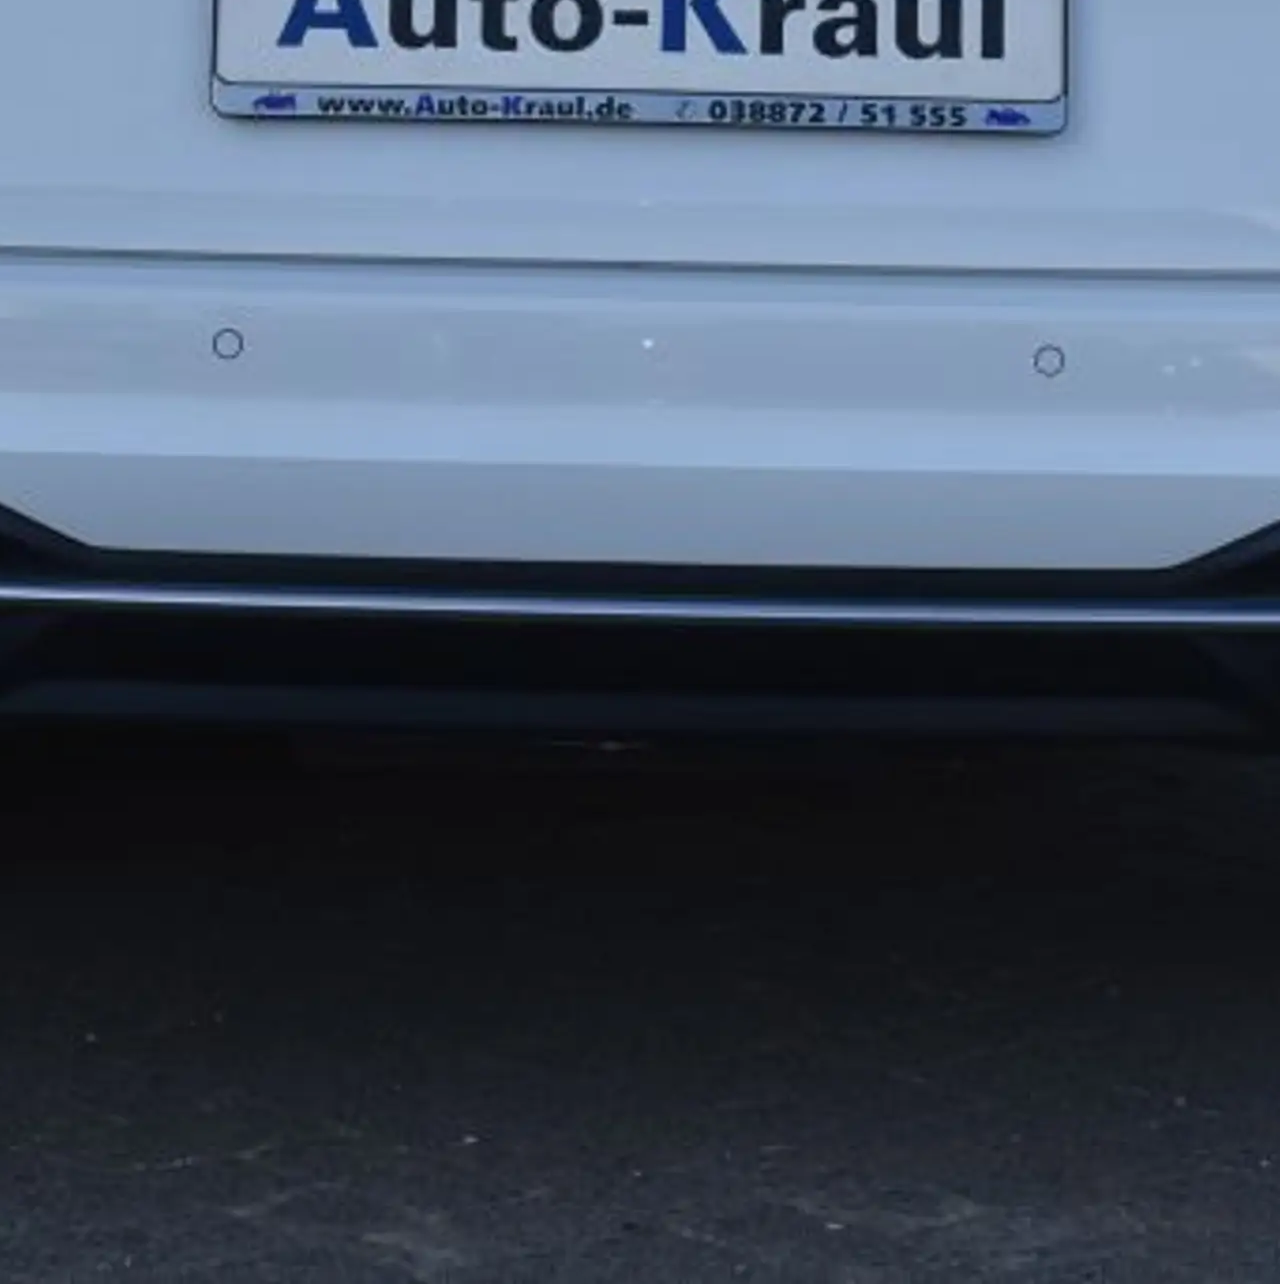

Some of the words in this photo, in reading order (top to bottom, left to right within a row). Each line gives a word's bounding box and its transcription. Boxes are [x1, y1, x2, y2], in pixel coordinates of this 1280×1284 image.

[318, 94, 635, 119] www.Auto-Kraul.de
[708, 100, 826, 123] 038872
[858, 102, 896, 125] 51
[909, 104, 968, 127] 555
